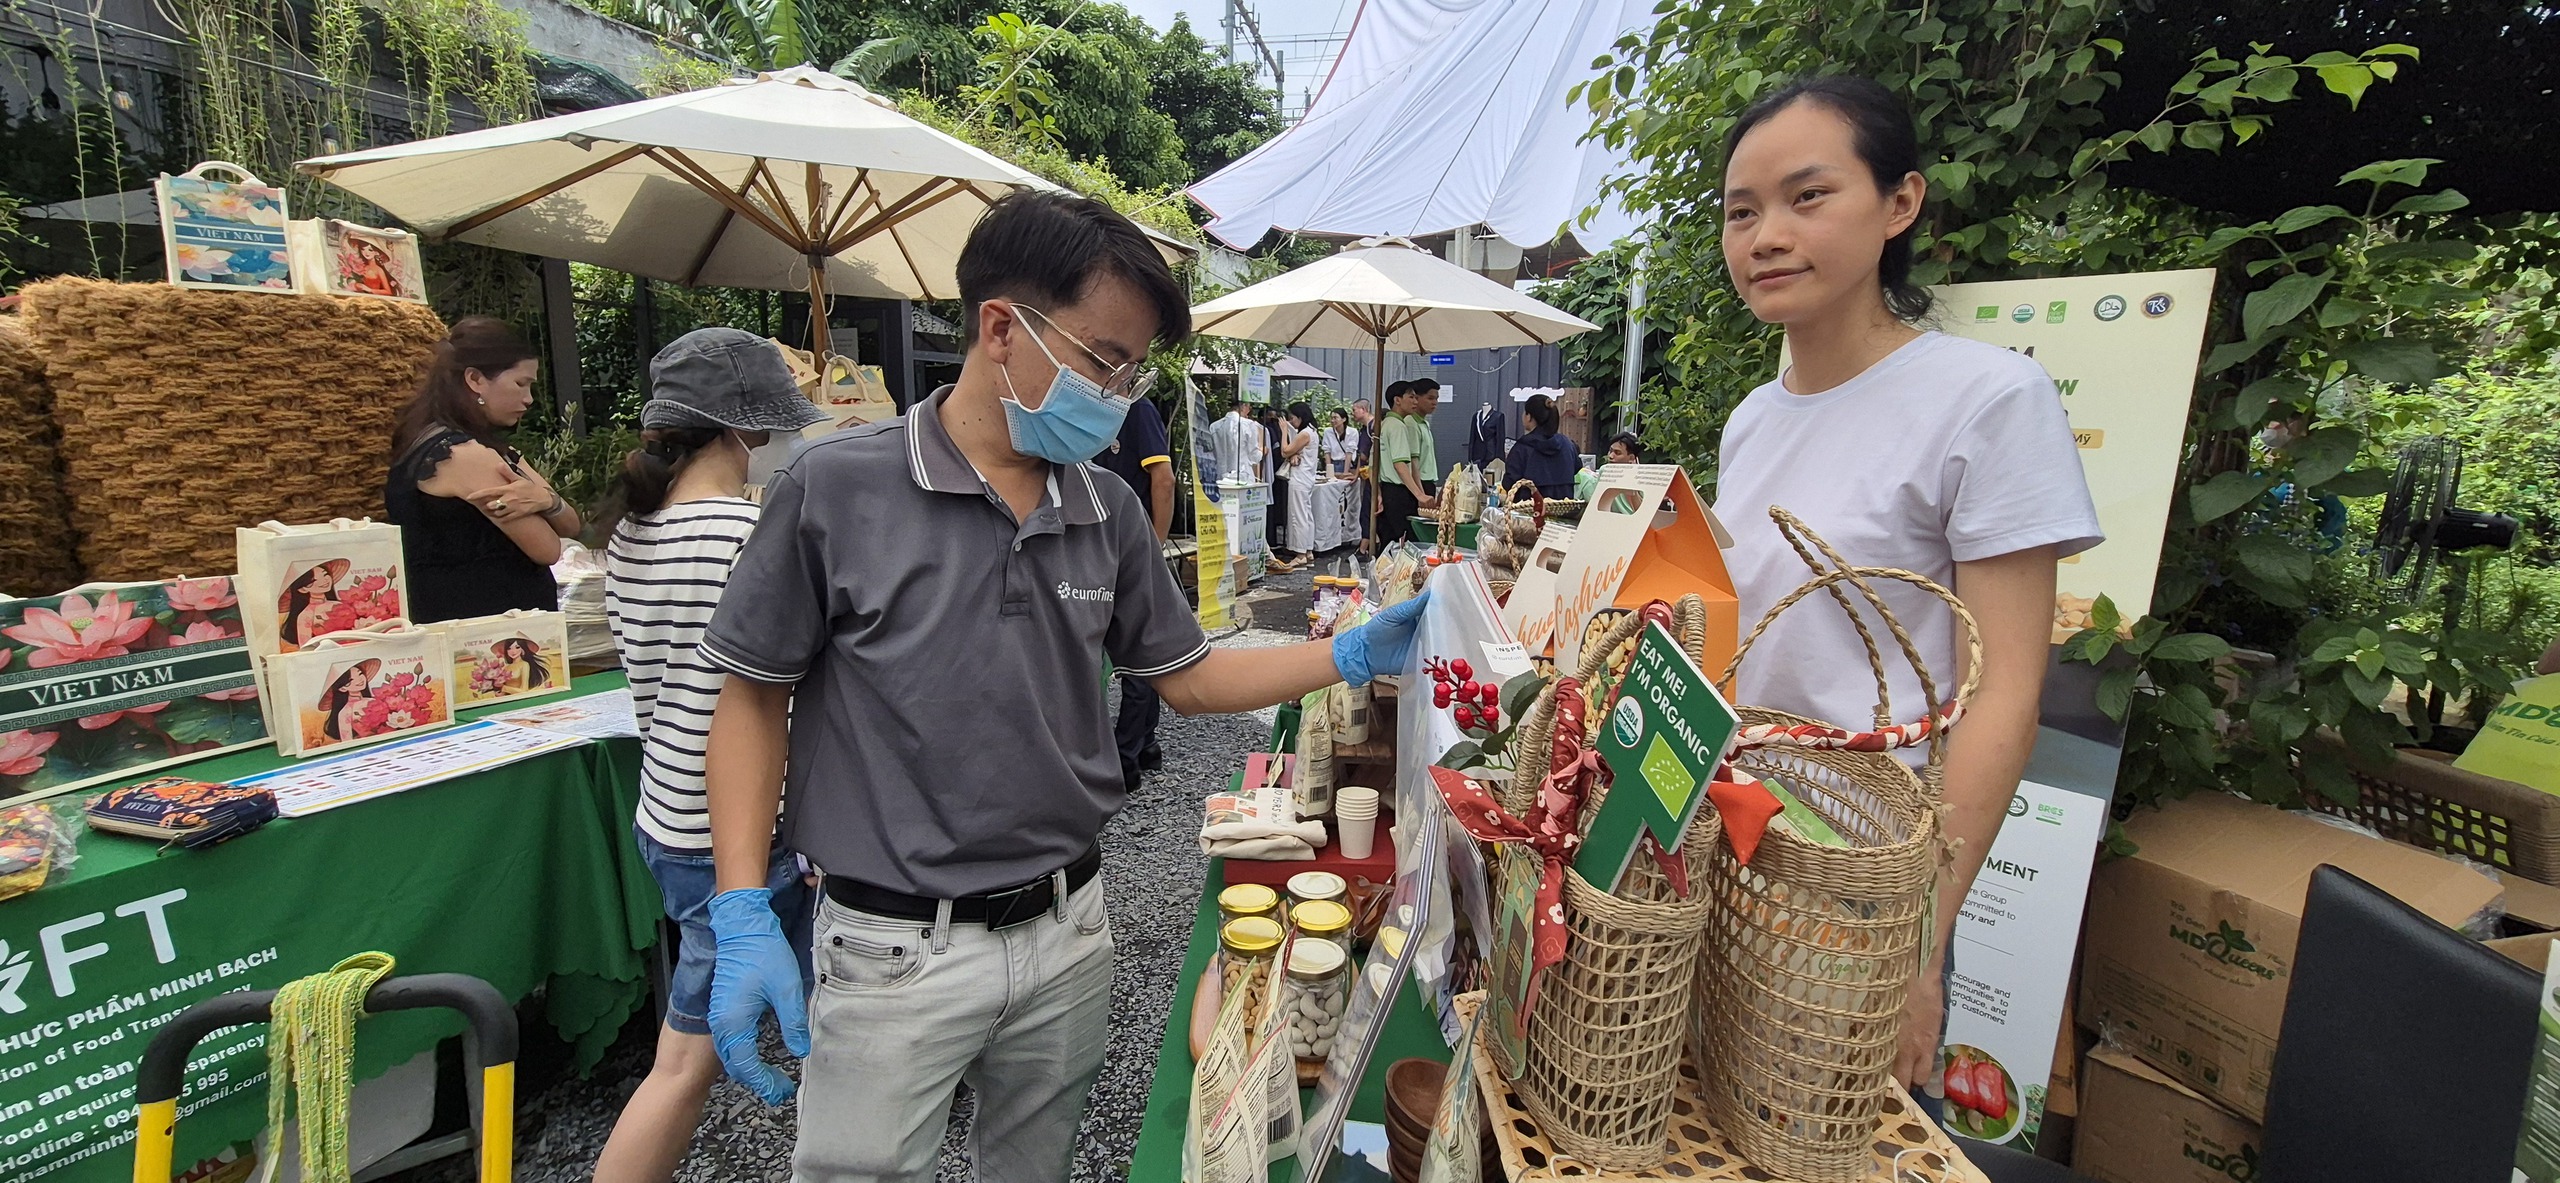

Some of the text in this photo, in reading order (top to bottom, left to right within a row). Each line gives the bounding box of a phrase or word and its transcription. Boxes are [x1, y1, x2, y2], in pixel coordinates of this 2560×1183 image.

[197, 227, 265, 242] VIET NAM
[2073, 433, 2091, 445] Mỹ
[1071, 586, 1115, 602] eurofins
[1555, 555, 1627, 649] Cashew
[388, 655, 424, 666] VIET NAM
[1640, 638, 1688, 701] EAT ME!
[28, 665, 175, 706] VIET NAM
[1622, 703, 1639, 729] USDA
[1631, 660, 1711, 766] I'M ORGANIC
[1986, 856, 2039, 882] MENT
[1963, 899, 2016, 921] ommitted to
[1980, 890, 2007, 905] Group
[1958, 909, 1996, 927] stry and
[67, 993, 146, 1031] PHẨM
[150, 969, 213, 1001] MINH
[217, 947, 279, 977] BẠCH
[1994, 987, 2011, 999] and
[1952, 990, 2007, 1016] produce, and
[1961, 1003, 2005, 1025] customers
[2000, 998, 2009, 1007] to
[44, 1047, 67, 1065] of
[72, 1027, 125, 1055] Food
[0, 1118, 49, 1145] ood
[184, 1034, 265, 1074] sparency
[37, 1084, 73, 1106] an
[75, 1060, 134, 1090] toàn
[0, 1131, 85, 1173] Hotline
[196, 1068, 230, 1091] 995
